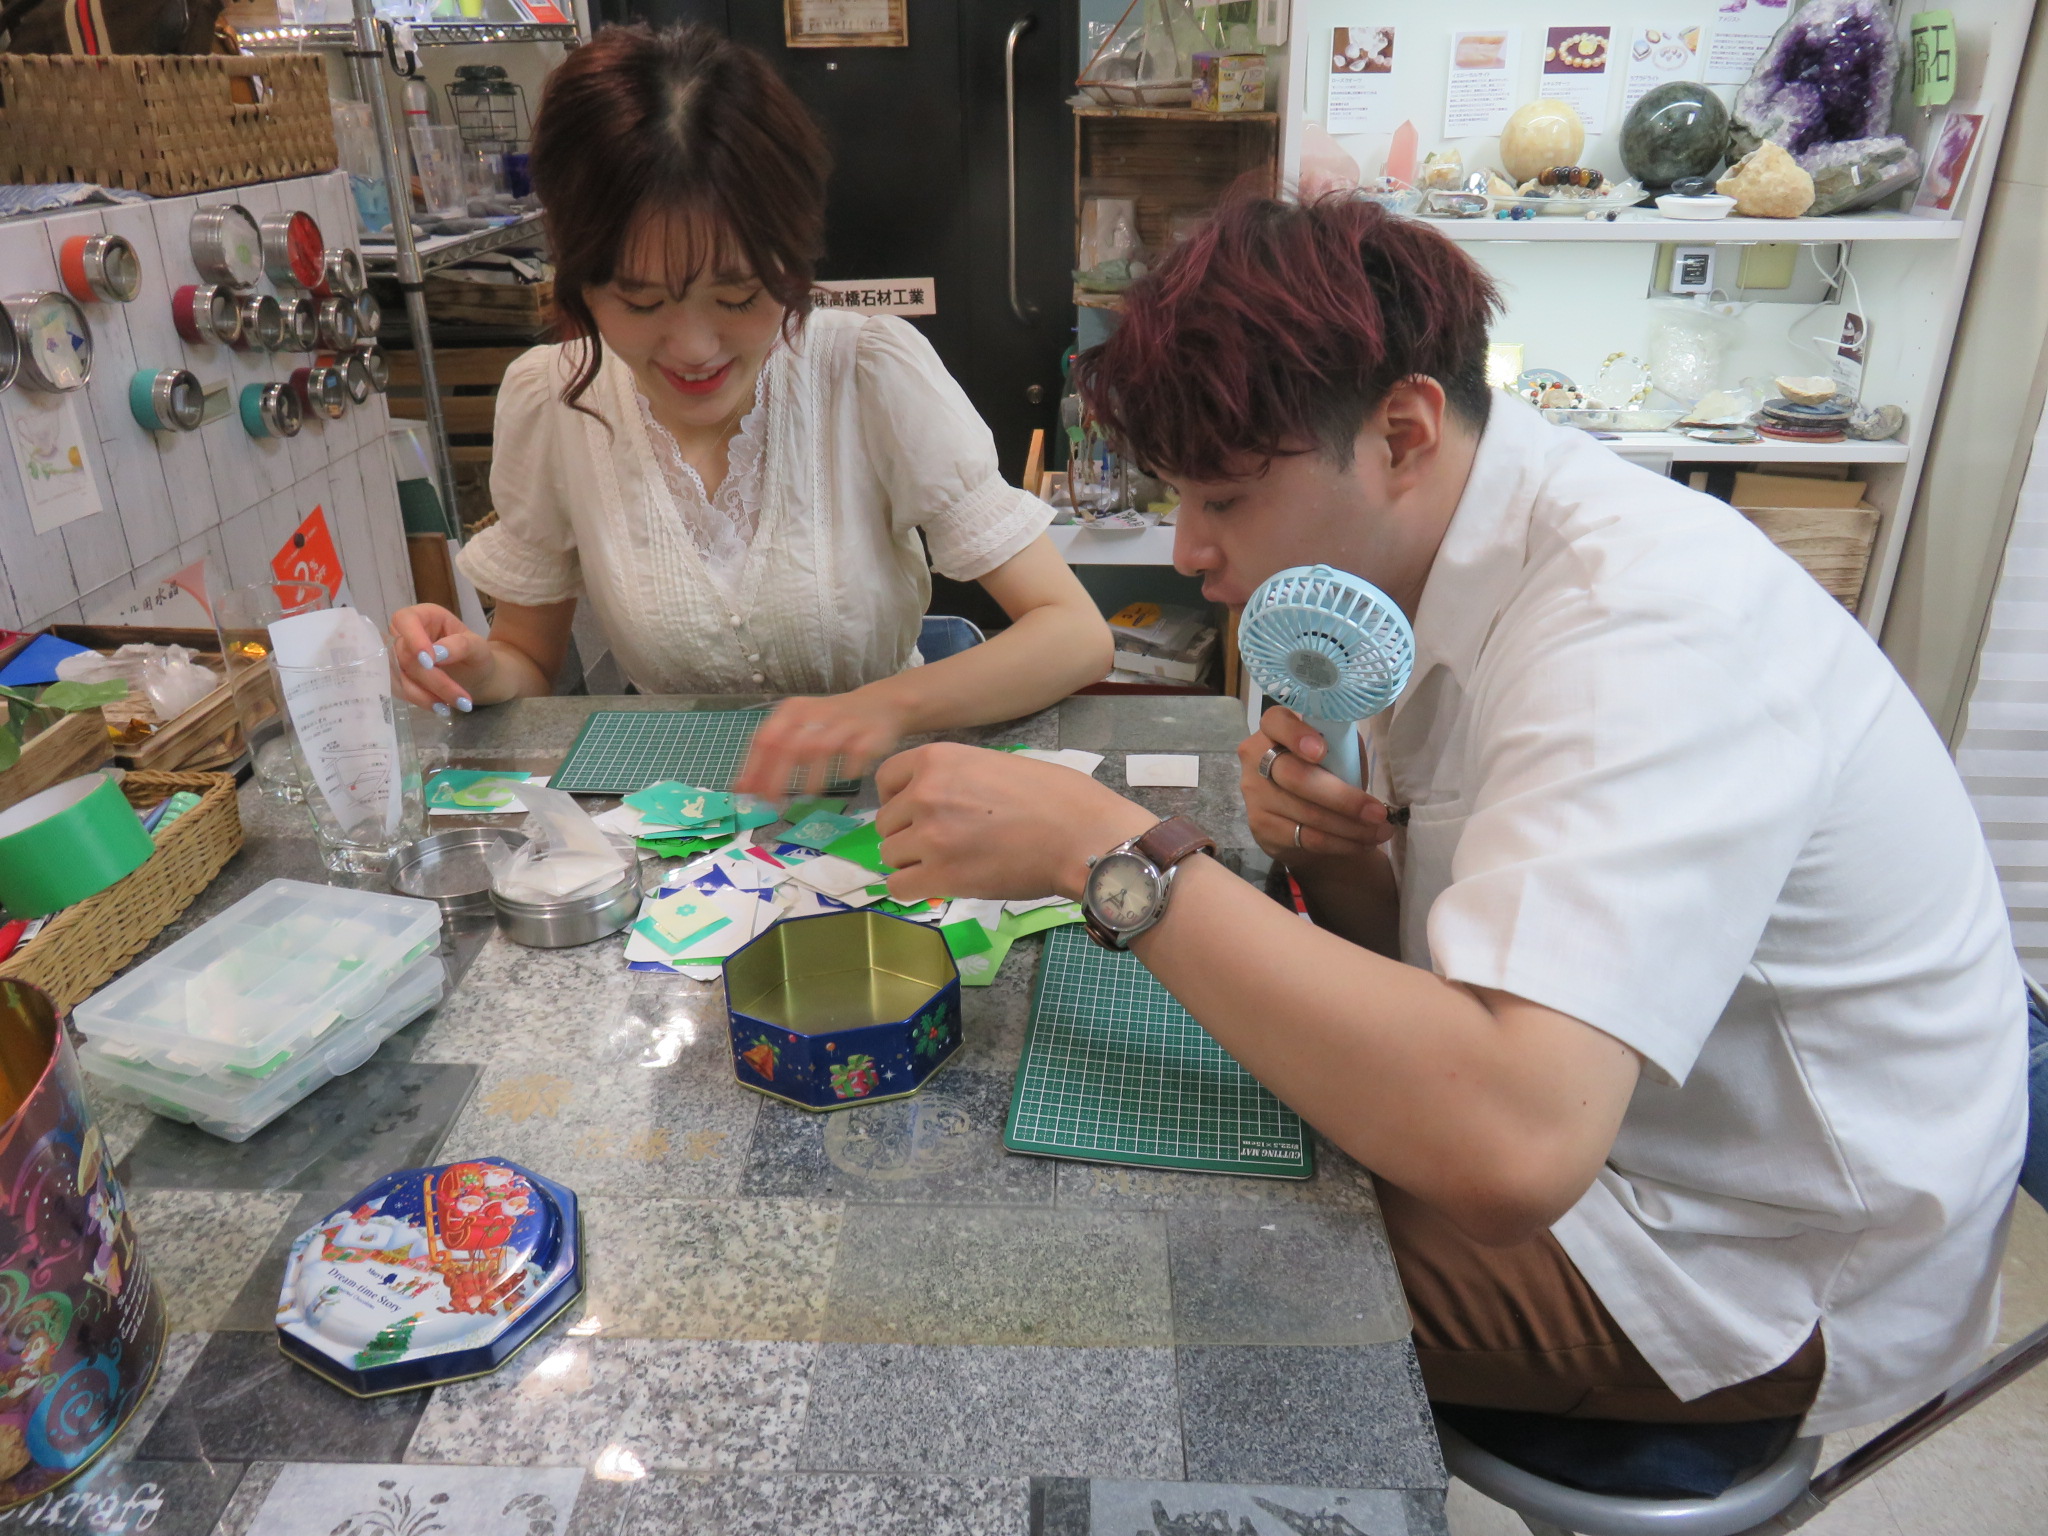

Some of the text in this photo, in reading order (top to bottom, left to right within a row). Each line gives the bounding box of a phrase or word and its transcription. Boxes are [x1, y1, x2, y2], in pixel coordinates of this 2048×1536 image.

[1240, 1148, 1301, 1159] CUTTING MAT
[328, 1267, 402, 1313] Dream-time Story
